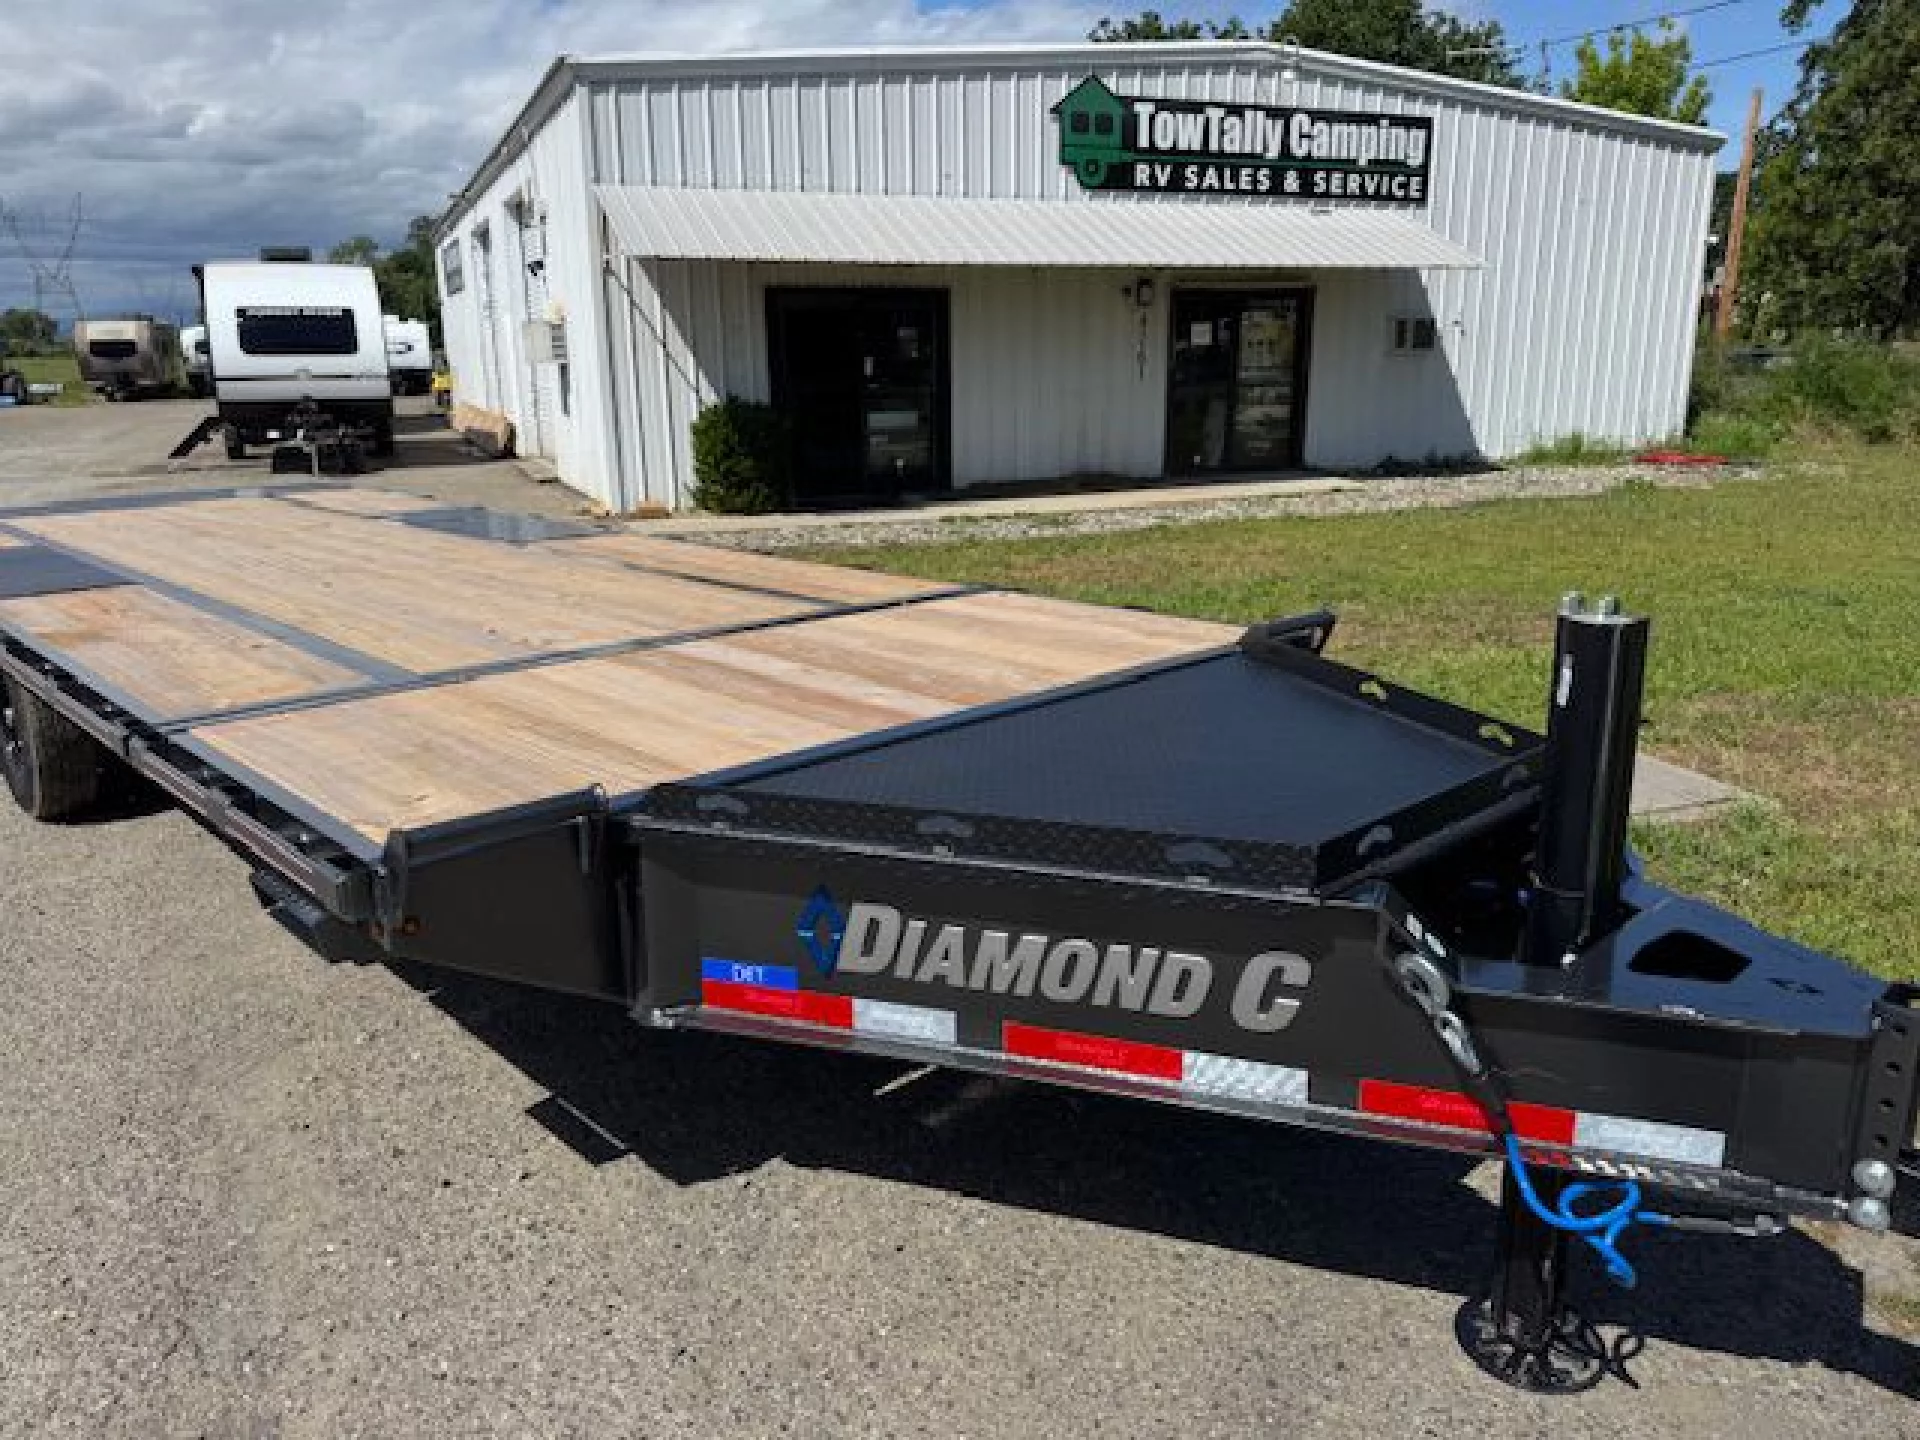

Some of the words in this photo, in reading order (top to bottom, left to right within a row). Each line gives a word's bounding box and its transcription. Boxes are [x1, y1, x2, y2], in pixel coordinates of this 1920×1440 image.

[1134, 101, 1284, 158] TowTally
[1289, 113, 1427, 167] Camping
[1134, 163, 1172, 187] RV
[1184, 167, 1271, 192] SALES
[1283, 172, 1302, 193] &
[1313, 174, 1424, 199] SERVICE
[837, 902, 1214, 1018] DIAMOND
[1230, 951, 1311, 1034] C
